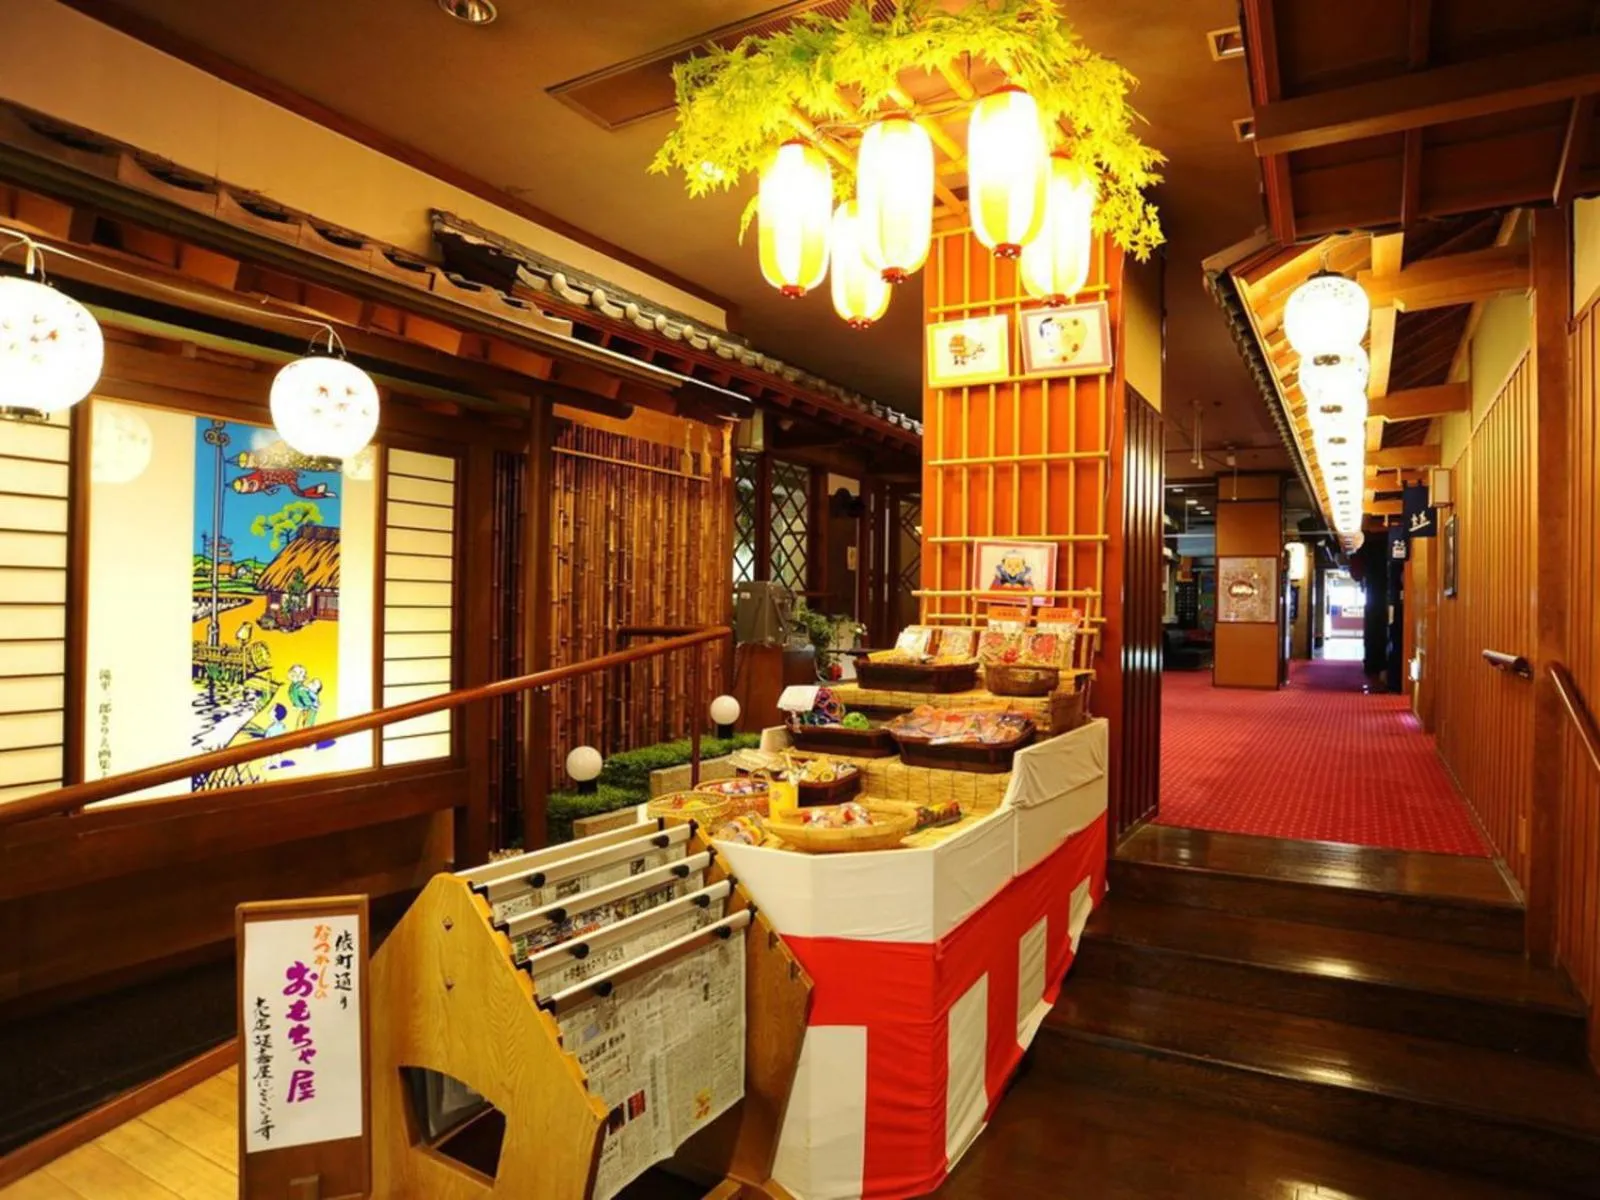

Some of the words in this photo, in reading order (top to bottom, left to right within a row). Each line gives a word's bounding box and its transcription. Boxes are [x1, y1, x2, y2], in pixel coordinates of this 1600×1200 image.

[283, 960, 318, 1103] おもちゃ屋
